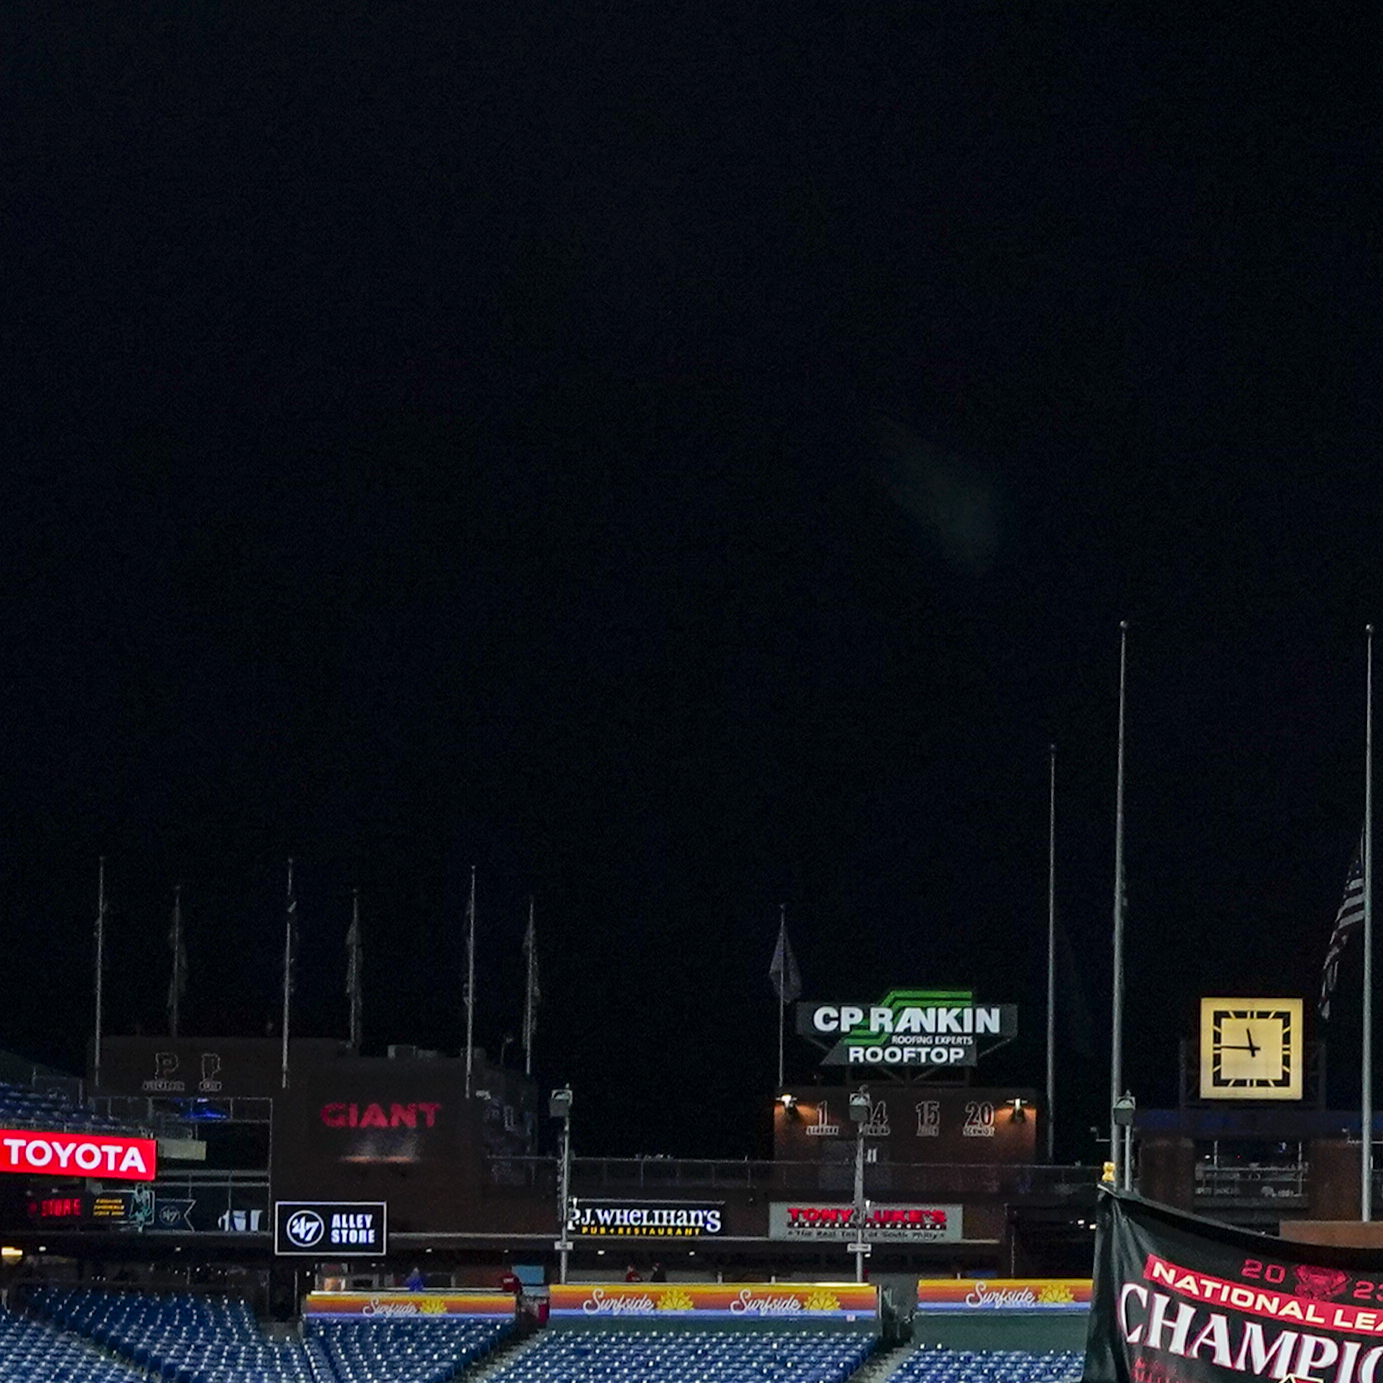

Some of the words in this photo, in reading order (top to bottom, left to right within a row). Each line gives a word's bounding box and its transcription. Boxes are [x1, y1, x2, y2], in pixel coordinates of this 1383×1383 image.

[813, 1006, 863, 1032] CP
[870, 1006, 1000, 1033] RANKIN
[892, 1035, 933, 1045] ROOFING
[935, 1035, 973, 1045] EXPERTS
[849, 1047, 965, 1064] ROOFTOP
[320, 1103, 442, 1128] GIANT
[965, 1101, 995, 1127] 20
[3, 1138, 147, 1173] TOYOTA
[332, 1214, 373, 1229] ALLEY
[787, 1208, 854, 1222] TONY
[331, 1230, 375, 1244] STORE
[582, 1227, 606, 1235] PUB
[618, 1227, 701, 1236] RESTAURANT
[1241, 1259, 1286, 1284] 20
[583, 1288, 654, 1316] Surfside
[730, 1289, 801, 1316] Surfside
[966, 1281, 1035, 1308] Surfside
[1150, 1260, 1326, 1325] NATIONAL
